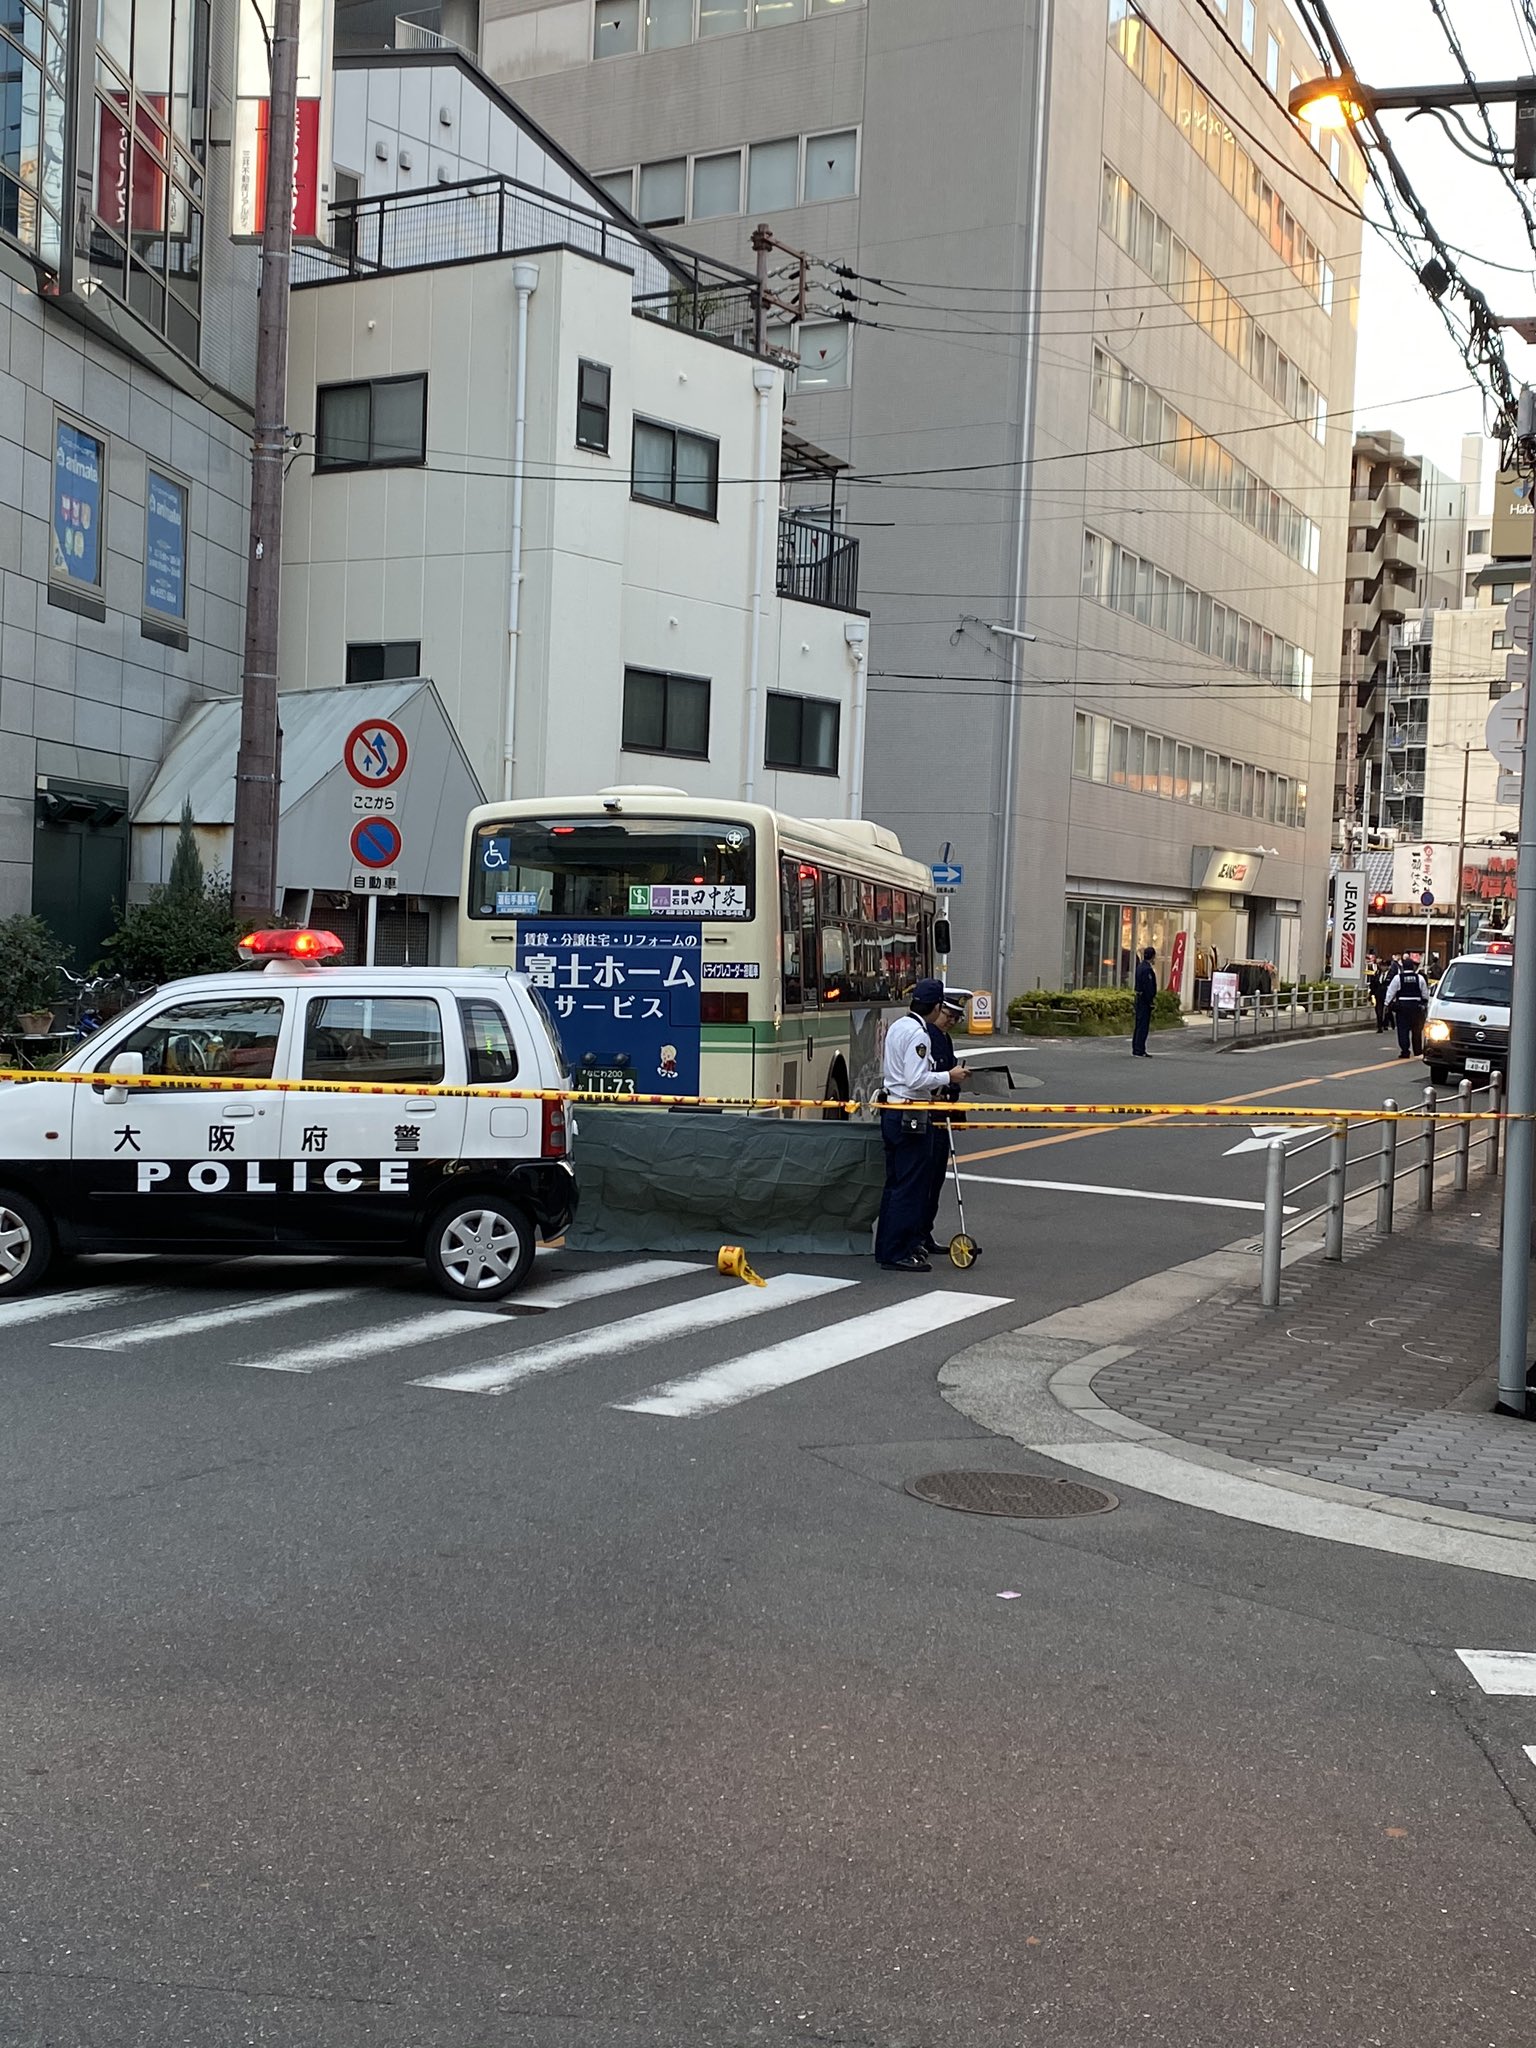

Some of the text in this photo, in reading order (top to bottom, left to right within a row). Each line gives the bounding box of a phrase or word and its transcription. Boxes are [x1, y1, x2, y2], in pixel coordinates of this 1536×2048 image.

[353, 796, 394, 810] ここから
[353, 875, 397, 889] 自動車
[691, 886, 743, 910] 田中家
[1342, 881, 1358, 932] JEANS
[524, 932, 698, 947] 賃貸・分譲住宅・リフォームの
[524, 952, 697, 989] 富士ホーム
[554, 994, 664, 1019] サービス
[113, 1124, 421, 1153] 大阪府警
[137, 1161, 410, 1193] POLICE
